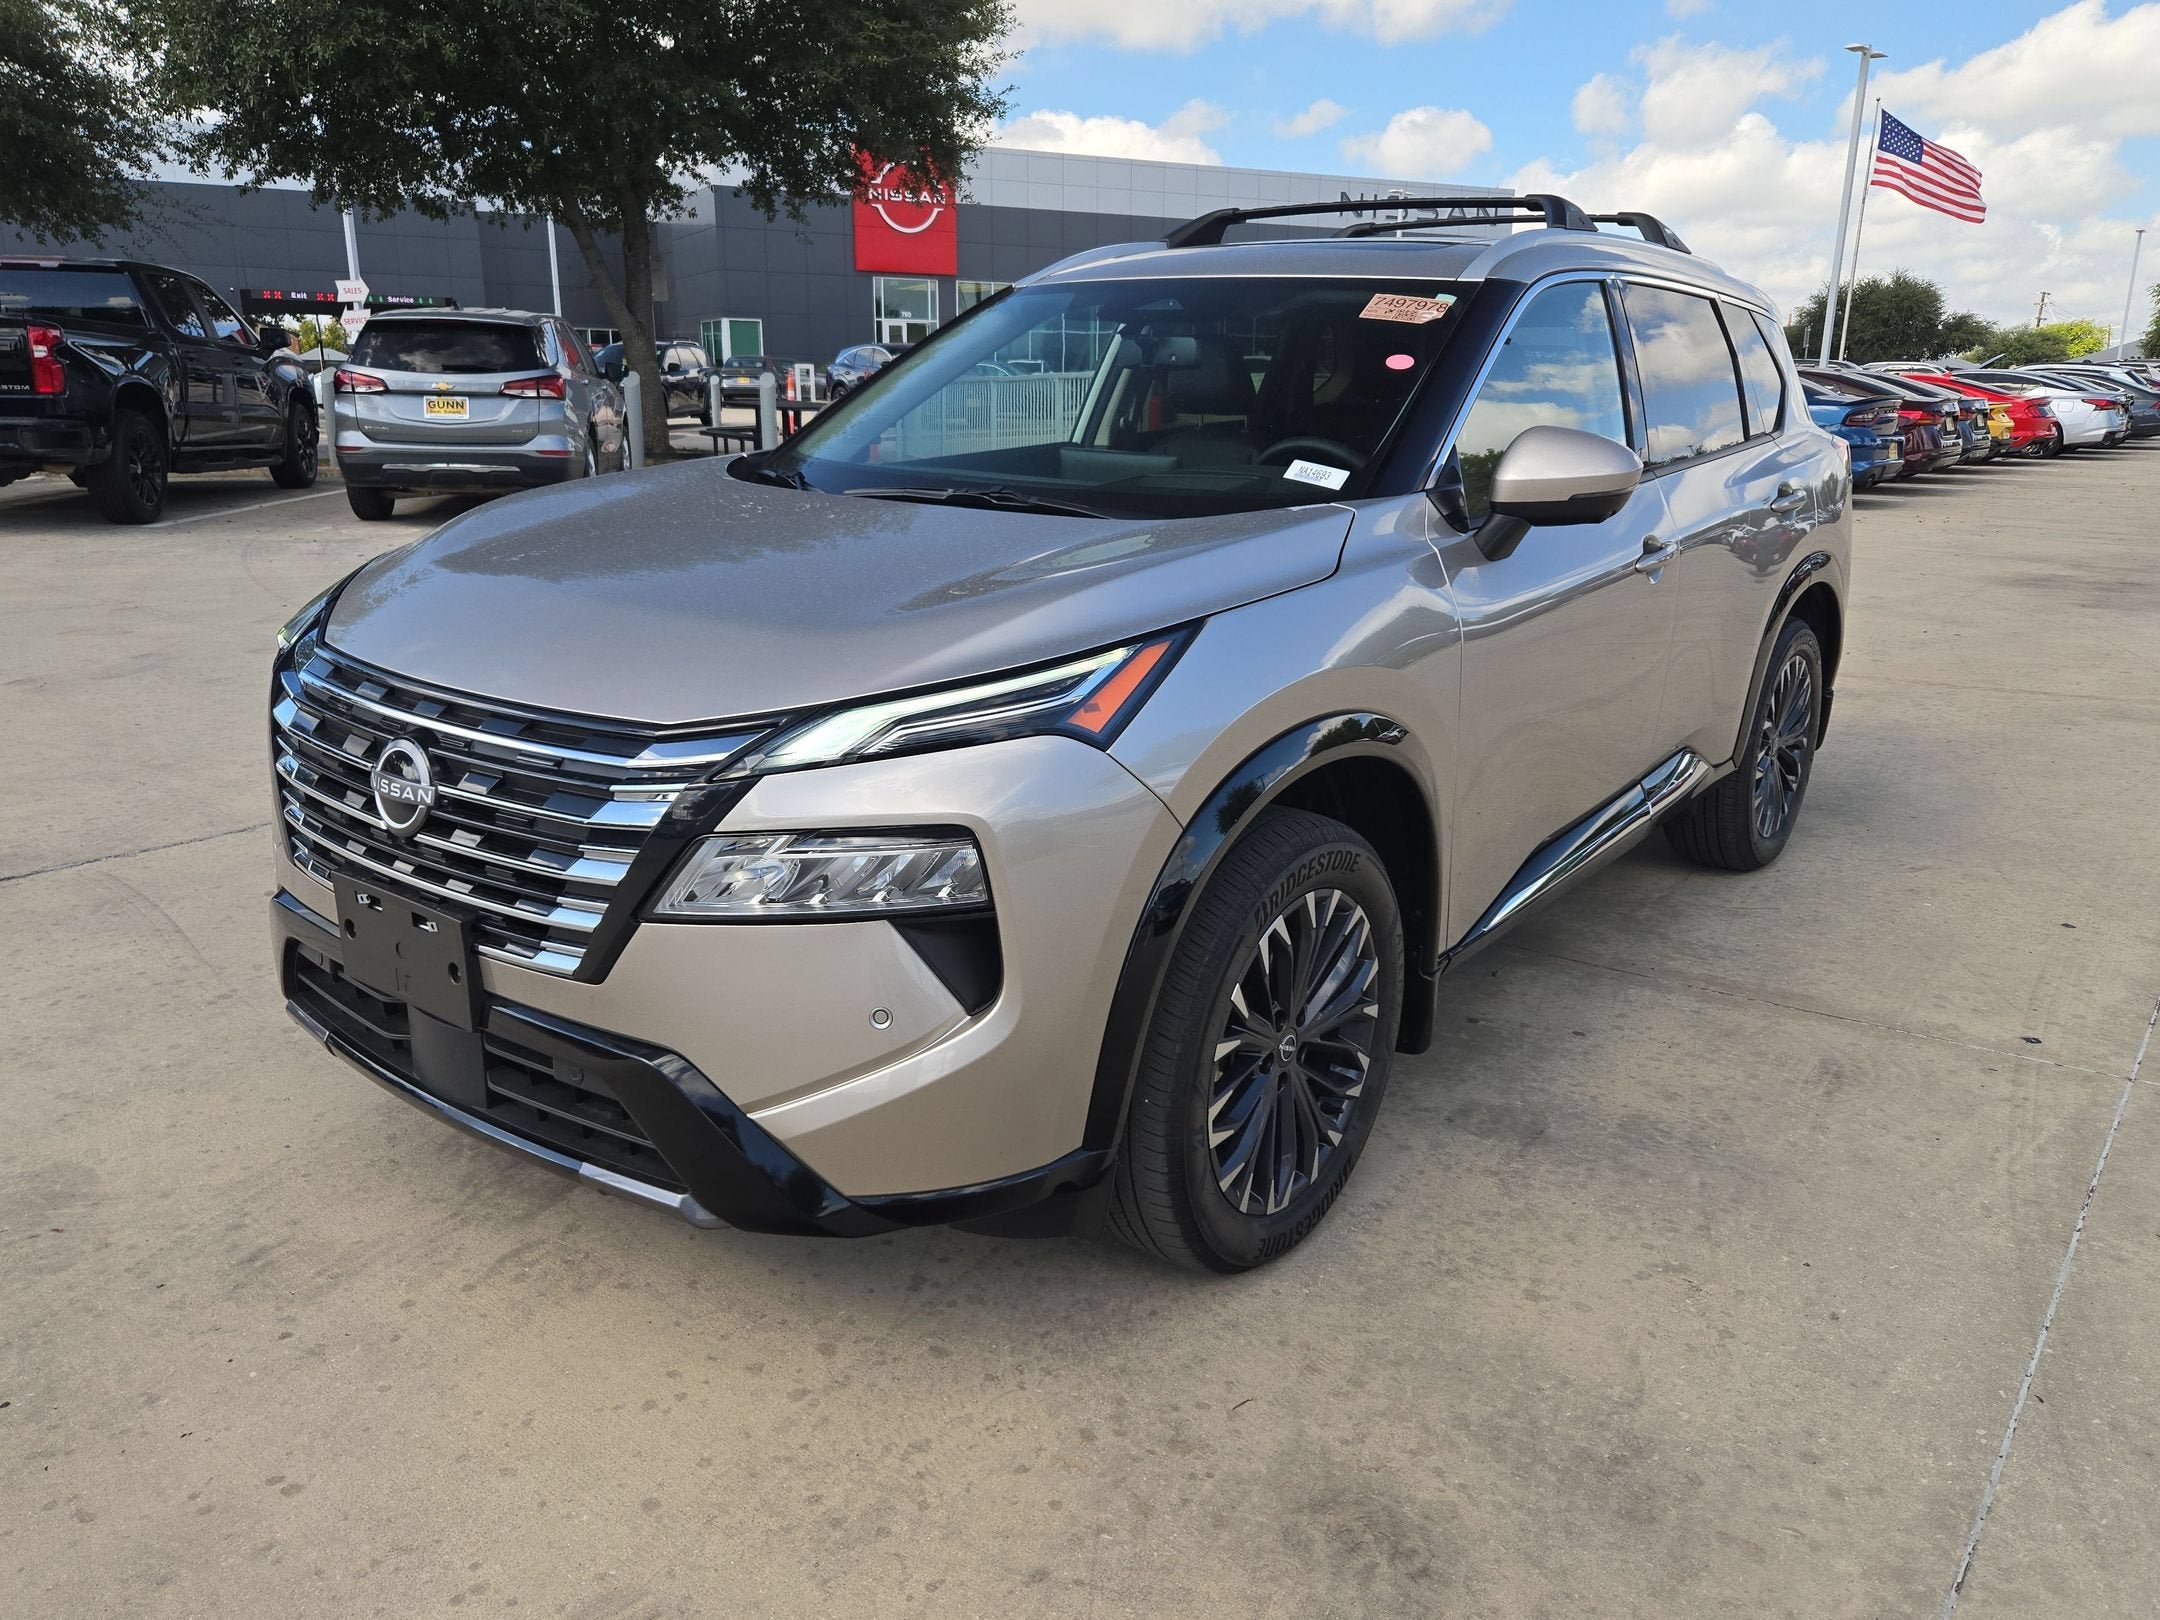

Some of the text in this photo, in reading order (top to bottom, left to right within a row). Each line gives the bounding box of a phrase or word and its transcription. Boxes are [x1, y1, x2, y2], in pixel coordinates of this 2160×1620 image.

[868, 187, 946, 205] NISSAN
[291, 291, 308, 300] Exit
[343, 286, 362, 295] SALES
[387, 295, 415, 304] Service
[1374, 296, 1449, 313] 7497978
[428, 400, 465, 409] GUNN
[371, 770, 433, 804] NISSAN
[1255, 850, 1361, 926] BRIDGESTONE
